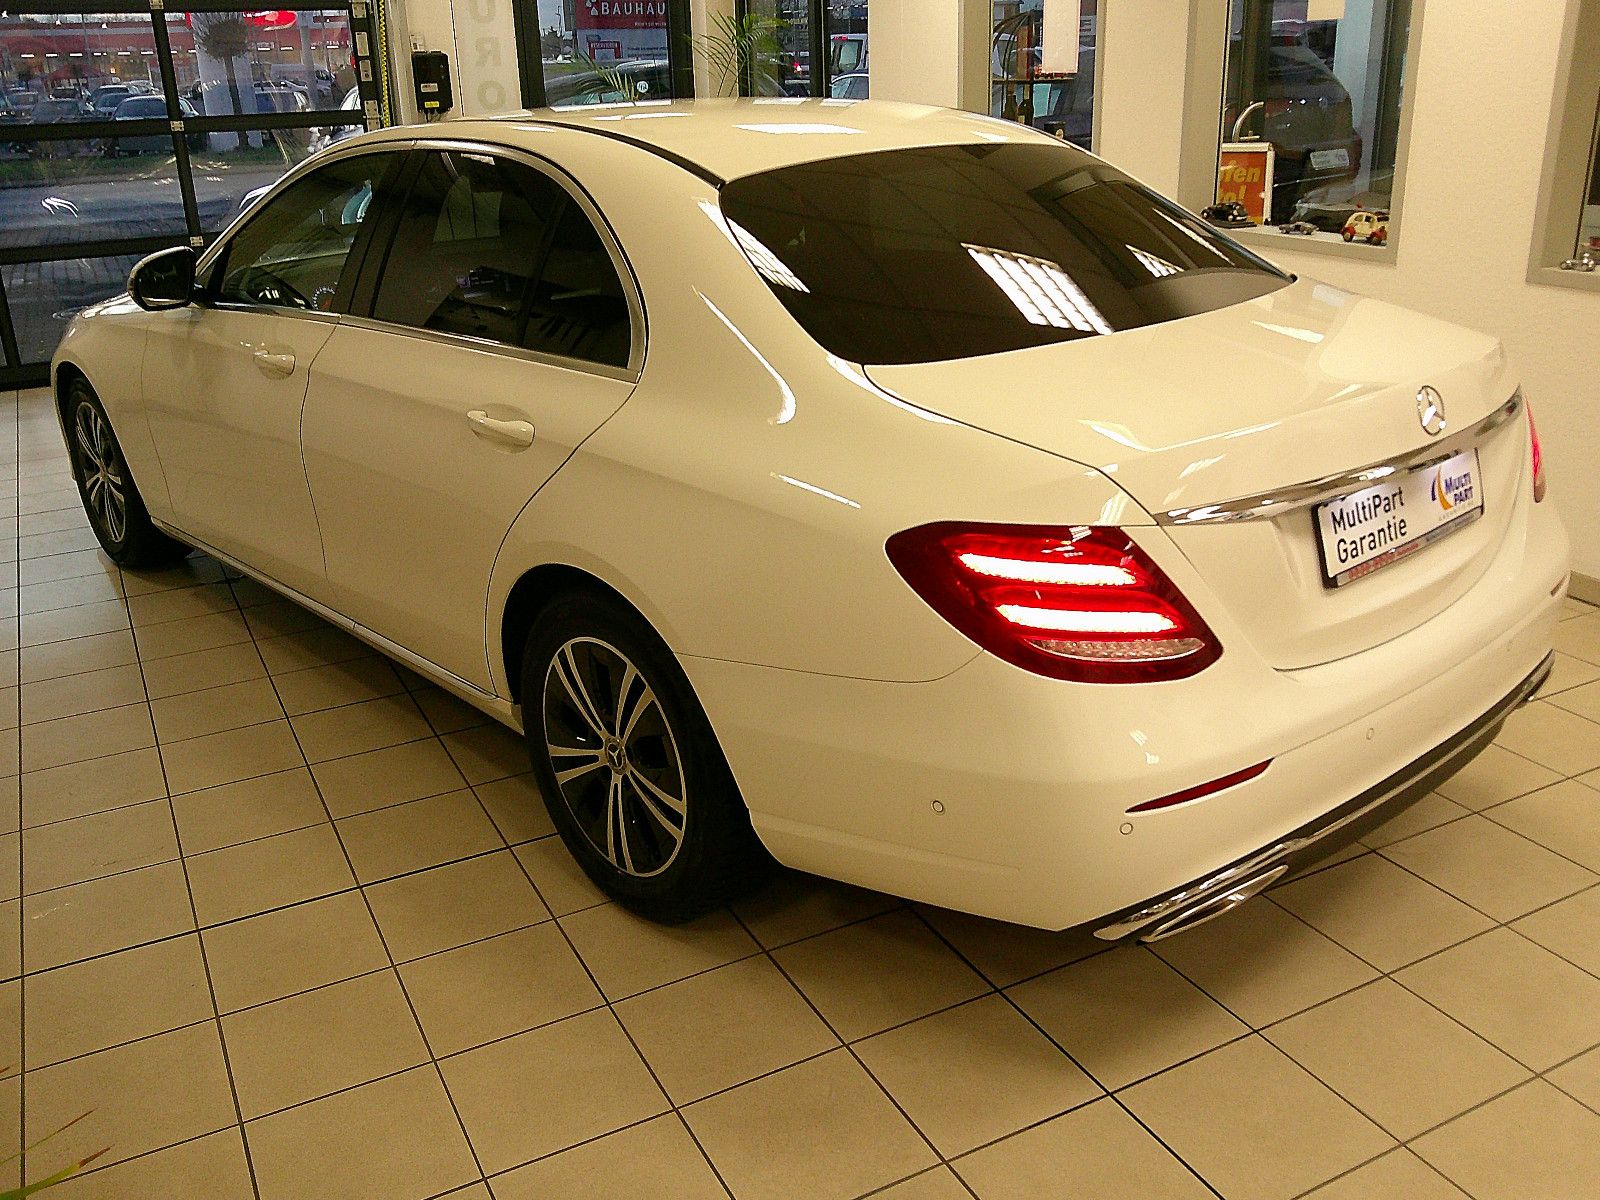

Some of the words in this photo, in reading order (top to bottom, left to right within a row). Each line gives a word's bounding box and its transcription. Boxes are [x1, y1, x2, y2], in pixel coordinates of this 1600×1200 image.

[601, 1, 666, 15] BAUHAU
[1331, 487, 1404, 534] MultiPart
[1336, 516, 1407, 564] Garantie
